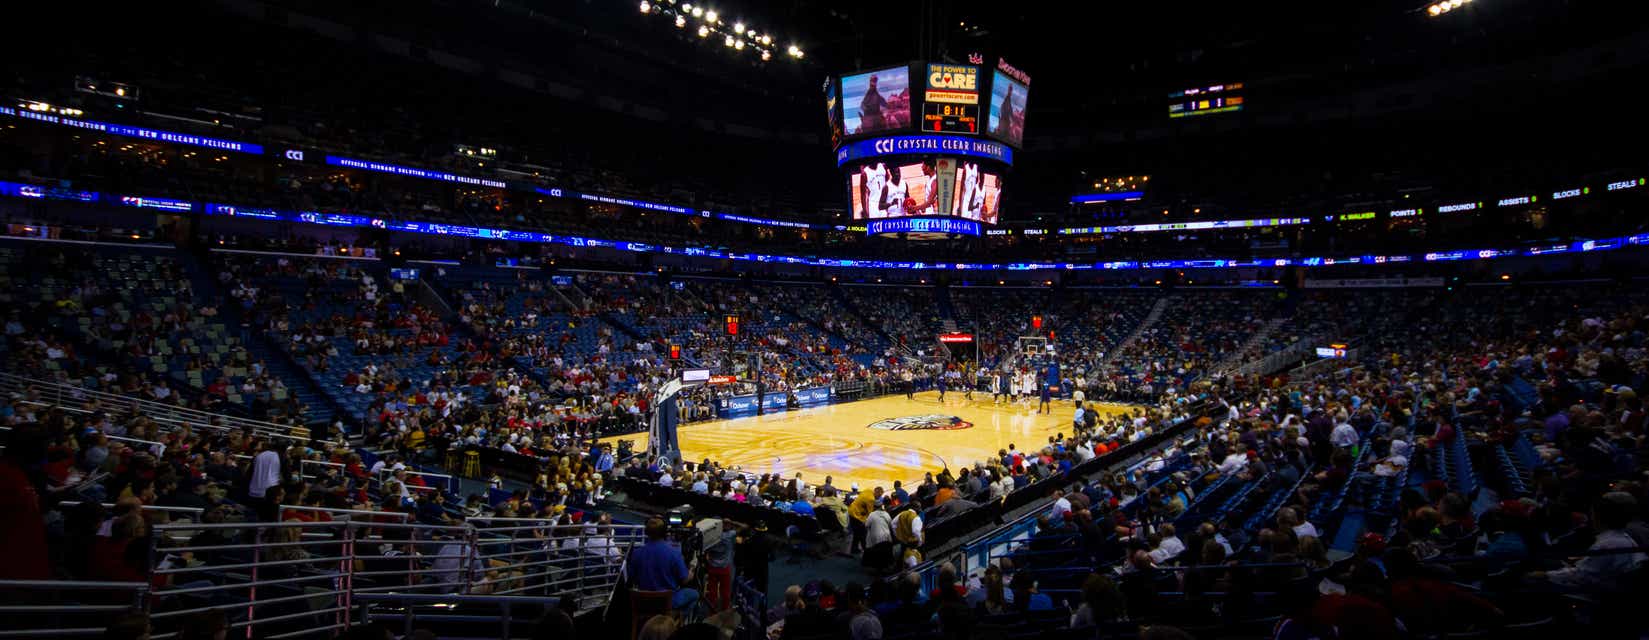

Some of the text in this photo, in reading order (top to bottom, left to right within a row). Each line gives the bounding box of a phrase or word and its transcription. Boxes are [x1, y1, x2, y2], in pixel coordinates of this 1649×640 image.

[944, 66, 966, 74] POWER
[930, 72, 976, 89] CARE
[944, 105, 964, 116] 8:11
[139, 130, 158, 139] NEW
[162, 133, 199, 145] ORLEANS
[203, 138, 242, 151] PELICANS
[875, 138, 1003, 157] CCI CRYSTAL CLEAR IMAGING
[286, 150, 303, 160] CCI
[1607, 180, 1637, 191] STEALS
[1553, 188, 1581, 199] BLOCKS
[1498, 196, 1530, 207] ASSISTS
[1438, 202, 1476, 213] REBOUNDS
[1389, 209, 1416, 218] POINTS
